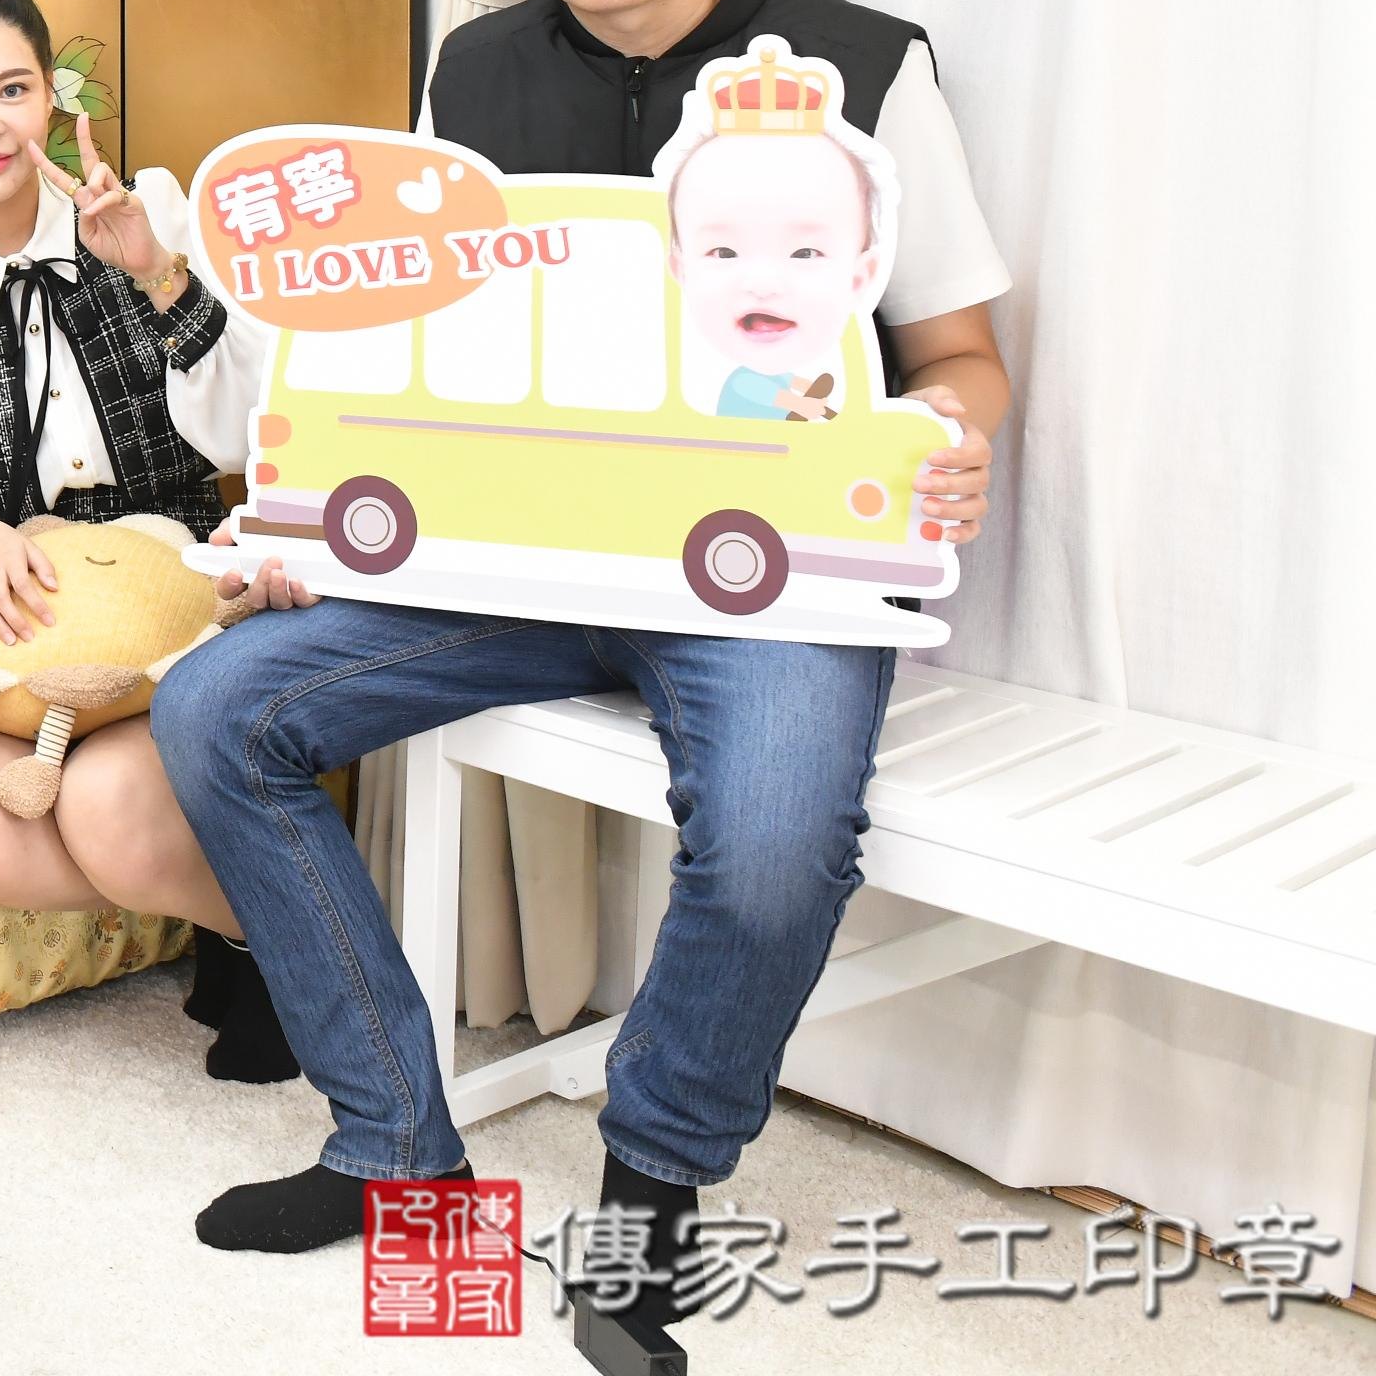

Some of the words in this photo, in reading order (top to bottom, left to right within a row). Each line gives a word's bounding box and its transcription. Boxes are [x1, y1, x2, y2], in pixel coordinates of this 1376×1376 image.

[218, 148, 355, 245] 宥寧
[237, 261, 259, 299] I
[284, 242, 427, 294] LOVE
[456, 227, 572, 274] YOU
